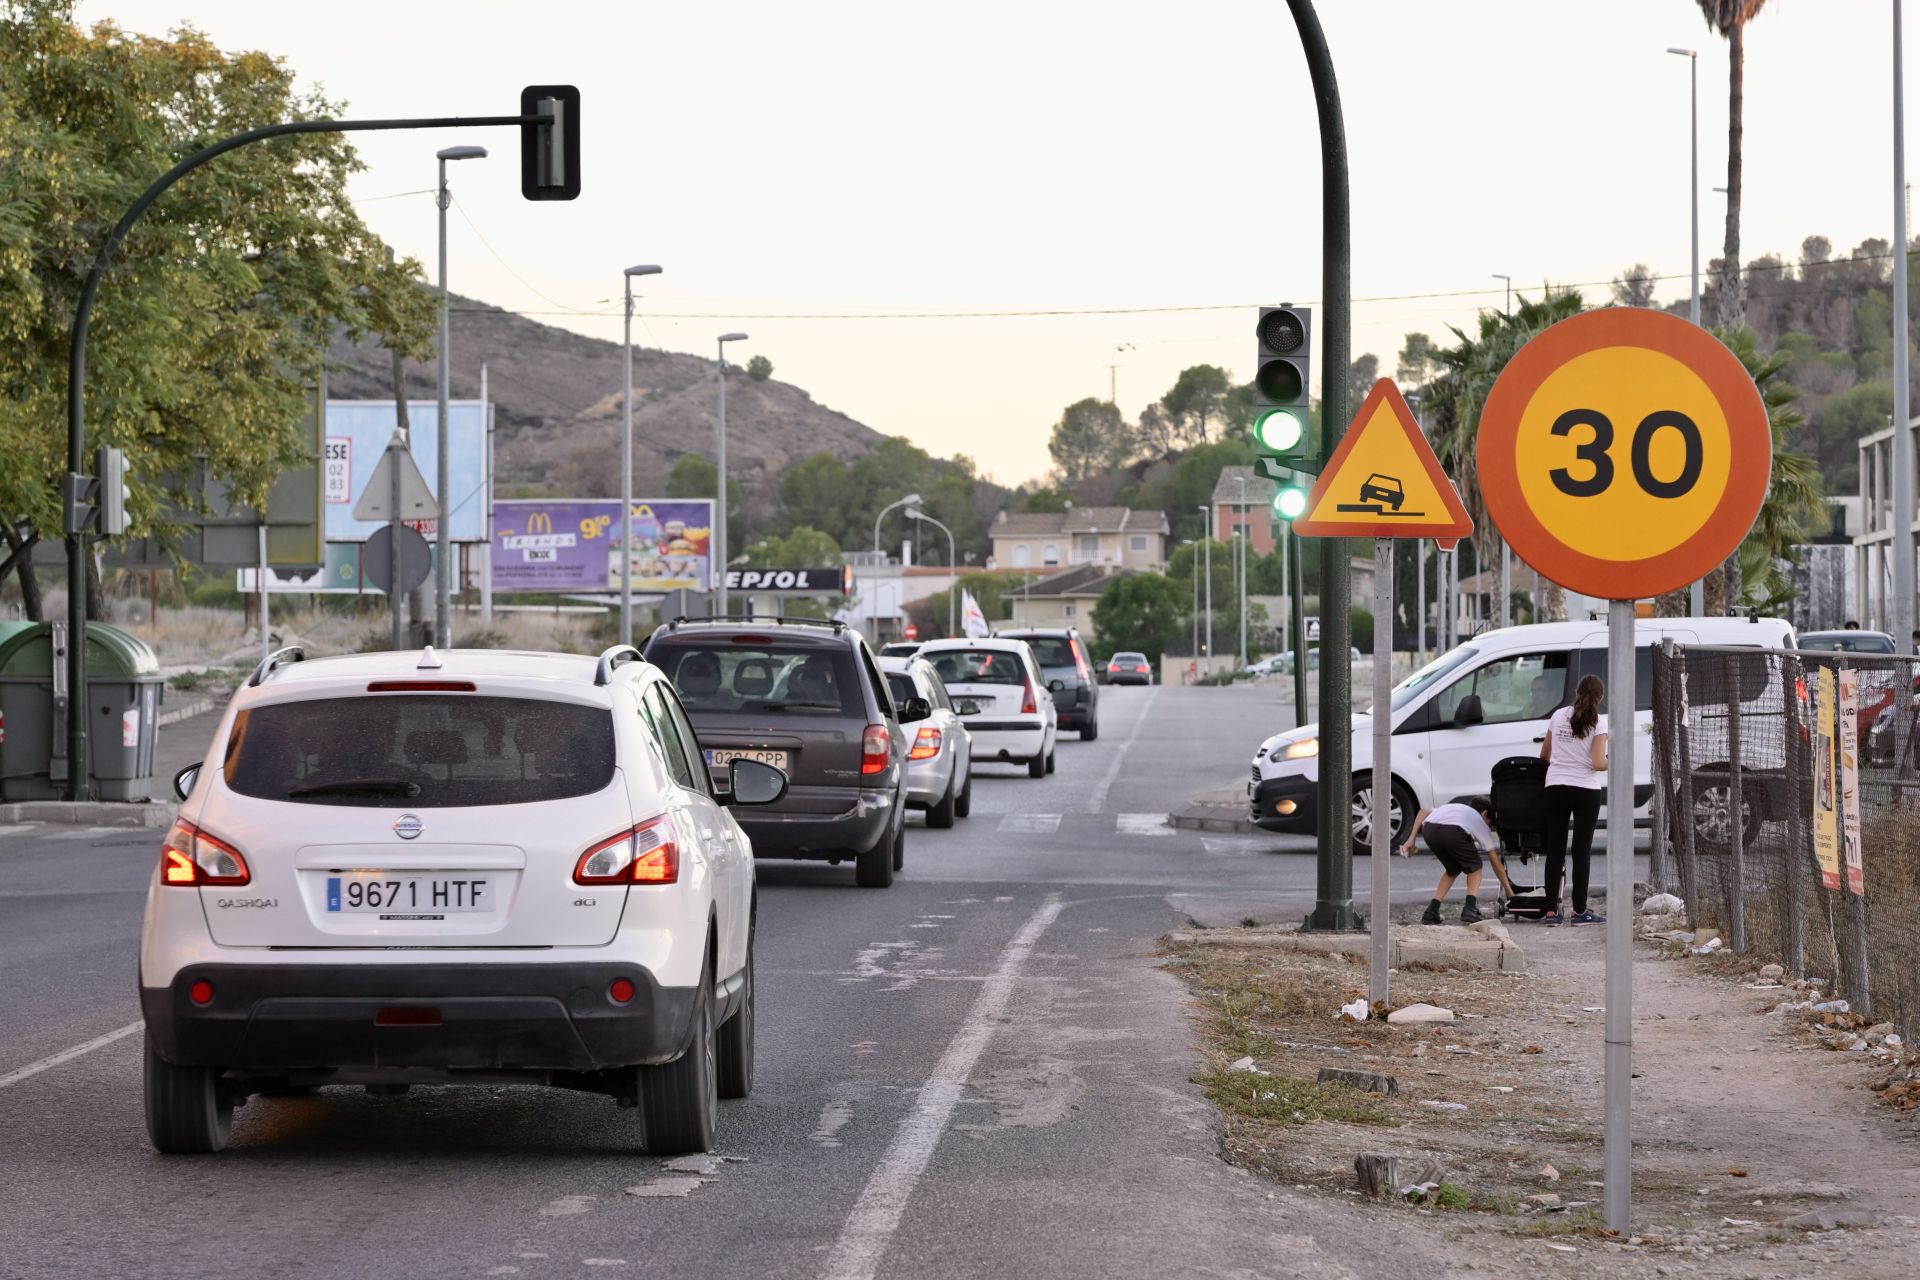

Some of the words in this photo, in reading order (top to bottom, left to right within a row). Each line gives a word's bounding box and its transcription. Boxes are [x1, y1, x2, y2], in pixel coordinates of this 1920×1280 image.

[325, 445, 347, 460] ESE
[1549, 408, 1704, 498] 30
[529, 550, 552, 560] BOX
[715, 571, 810, 588] EPSOL
[756, 752, 783, 766] CPP
[348, 881, 417, 908] 9671
[433, 880, 487, 907] HTF
[217, 898, 279, 909] QASHQAI
[573, 898, 596, 907] dCi
